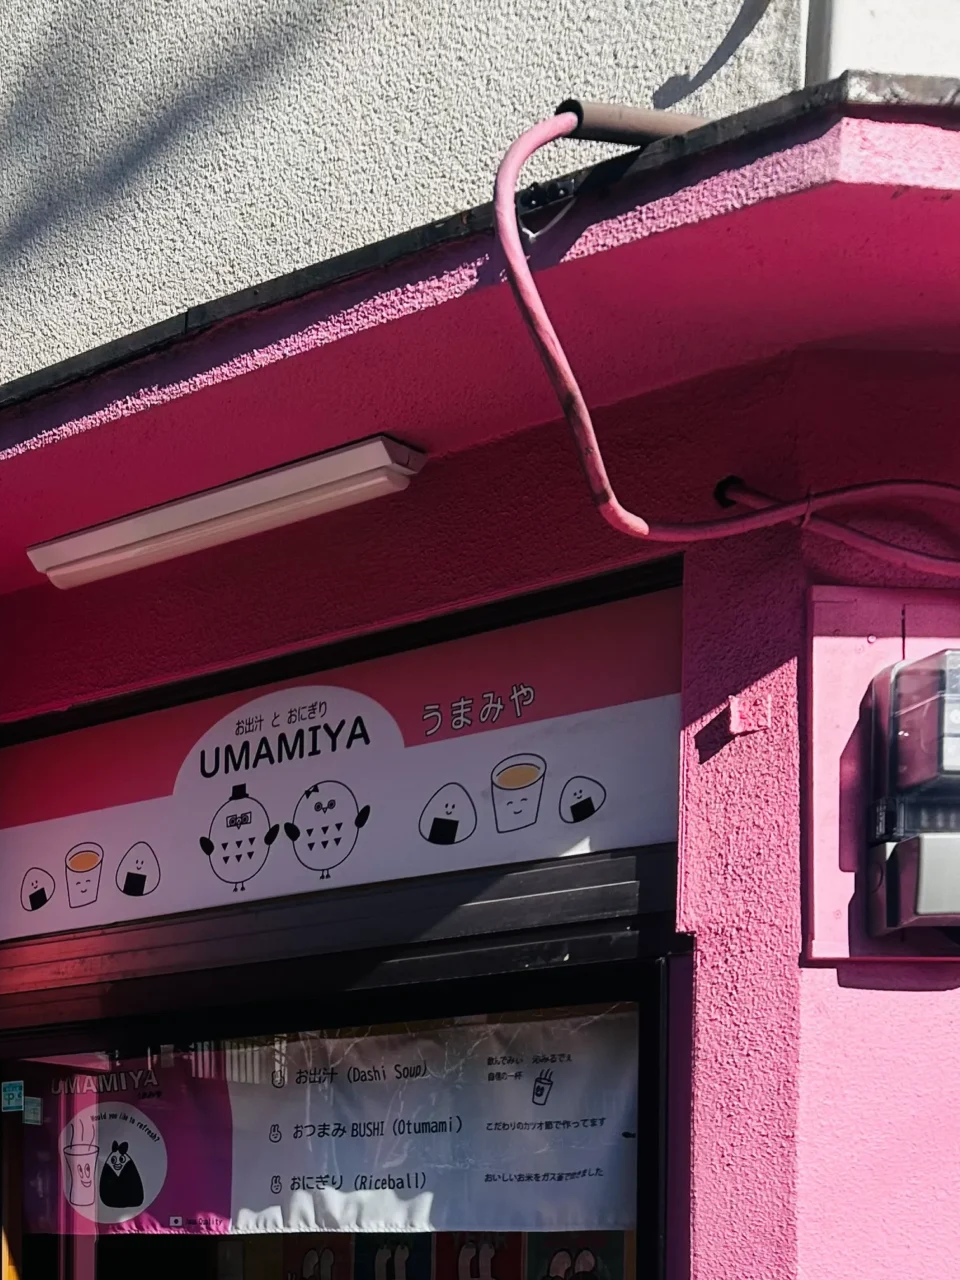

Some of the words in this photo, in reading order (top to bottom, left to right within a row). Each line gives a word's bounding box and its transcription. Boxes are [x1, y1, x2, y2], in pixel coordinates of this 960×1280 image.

[234, 715, 264, 736] お出汁
[271, 711, 281, 728] と
[287, 700, 328, 725] おにぎり
[421, 682, 537, 737] うまみや
[199, 715, 371, 779] UMAMIYA
[50, 1069, 159, 1095] UMAMIYA
[295, 1066, 338, 1084] お出汁
[346, 1064, 387, 1083] (Dashi
[394, 1059, 428, 1080] Soup)
[487, 1070, 524, 1082] 自信の一杯
[136, 1121, 161, 1143] refresh?
[292, 1121, 347, 1140] おつまみ
[350, 1120, 385, 1138] BUSHI
[289, 1174, 344, 1192] おにぎり
[353, 1171, 427, 1191] (Riceball)
